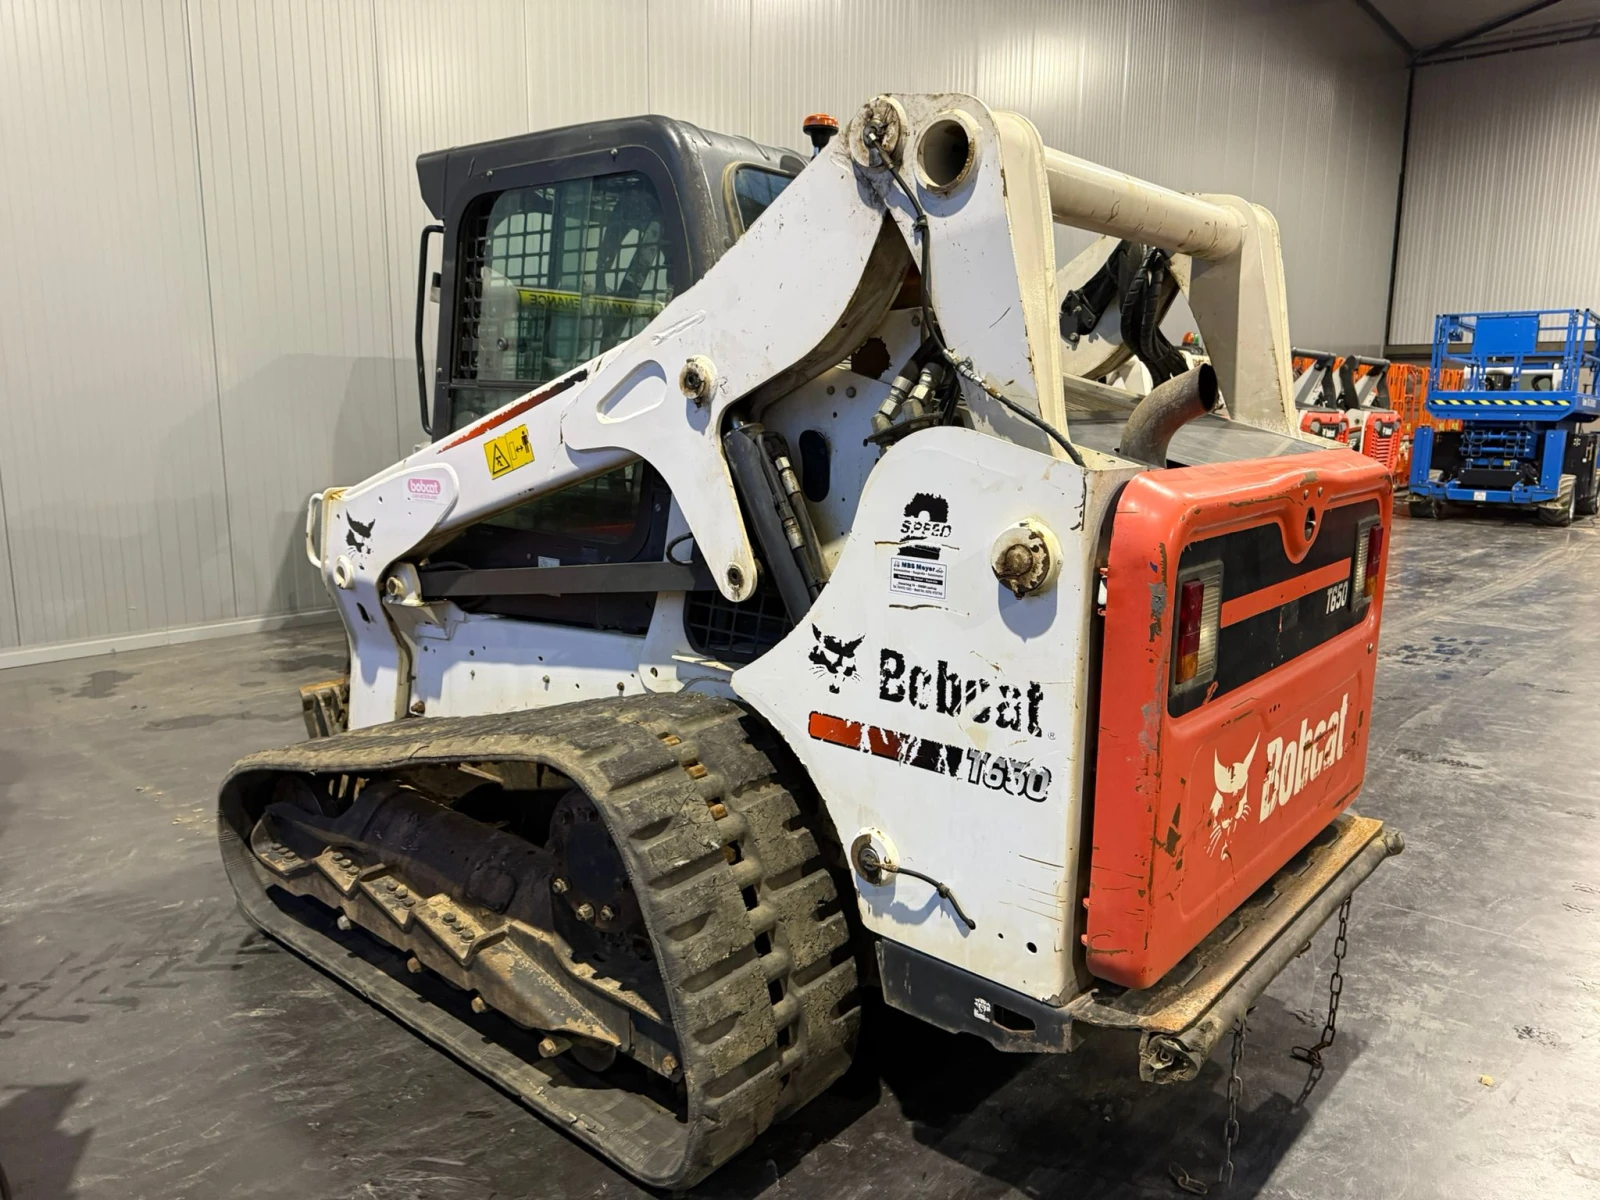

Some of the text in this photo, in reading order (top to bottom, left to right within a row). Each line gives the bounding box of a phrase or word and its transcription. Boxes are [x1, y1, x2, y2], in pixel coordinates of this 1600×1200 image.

[410, 479, 438, 494] bobcat
[901, 561, 936, 572] MBS Meyer
[1325, 581, 1349, 615] T650
[879, 648, 1044, 737] Bobcat
[966, 747, 1053, 802] T650
[1259, 692, 1349, 823] Bobcat
